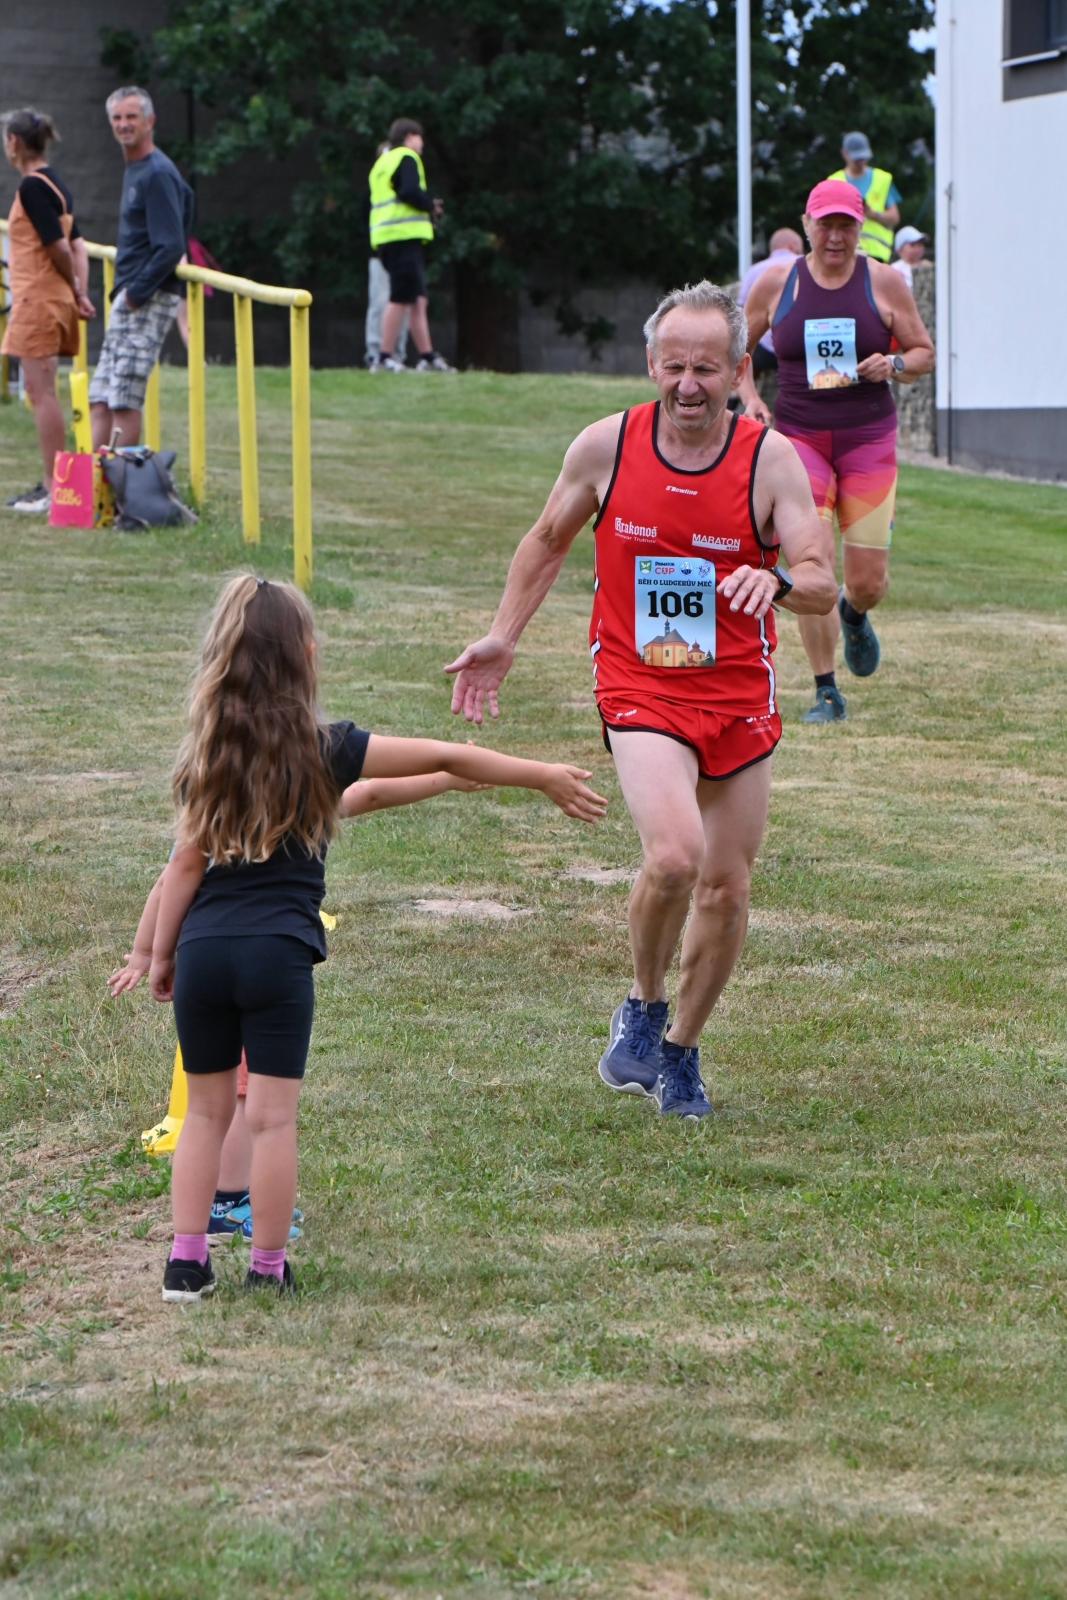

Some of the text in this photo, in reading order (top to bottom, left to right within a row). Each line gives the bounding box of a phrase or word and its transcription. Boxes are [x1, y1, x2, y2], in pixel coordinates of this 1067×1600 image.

[817, 340, 844, 358] 62
[692, 533, 741, 548] MARATON
[655, 567, 675, 575] CUP
[659, 579, 696, 587] LUDGERŮV
[647, 590, 704, 618] 106
